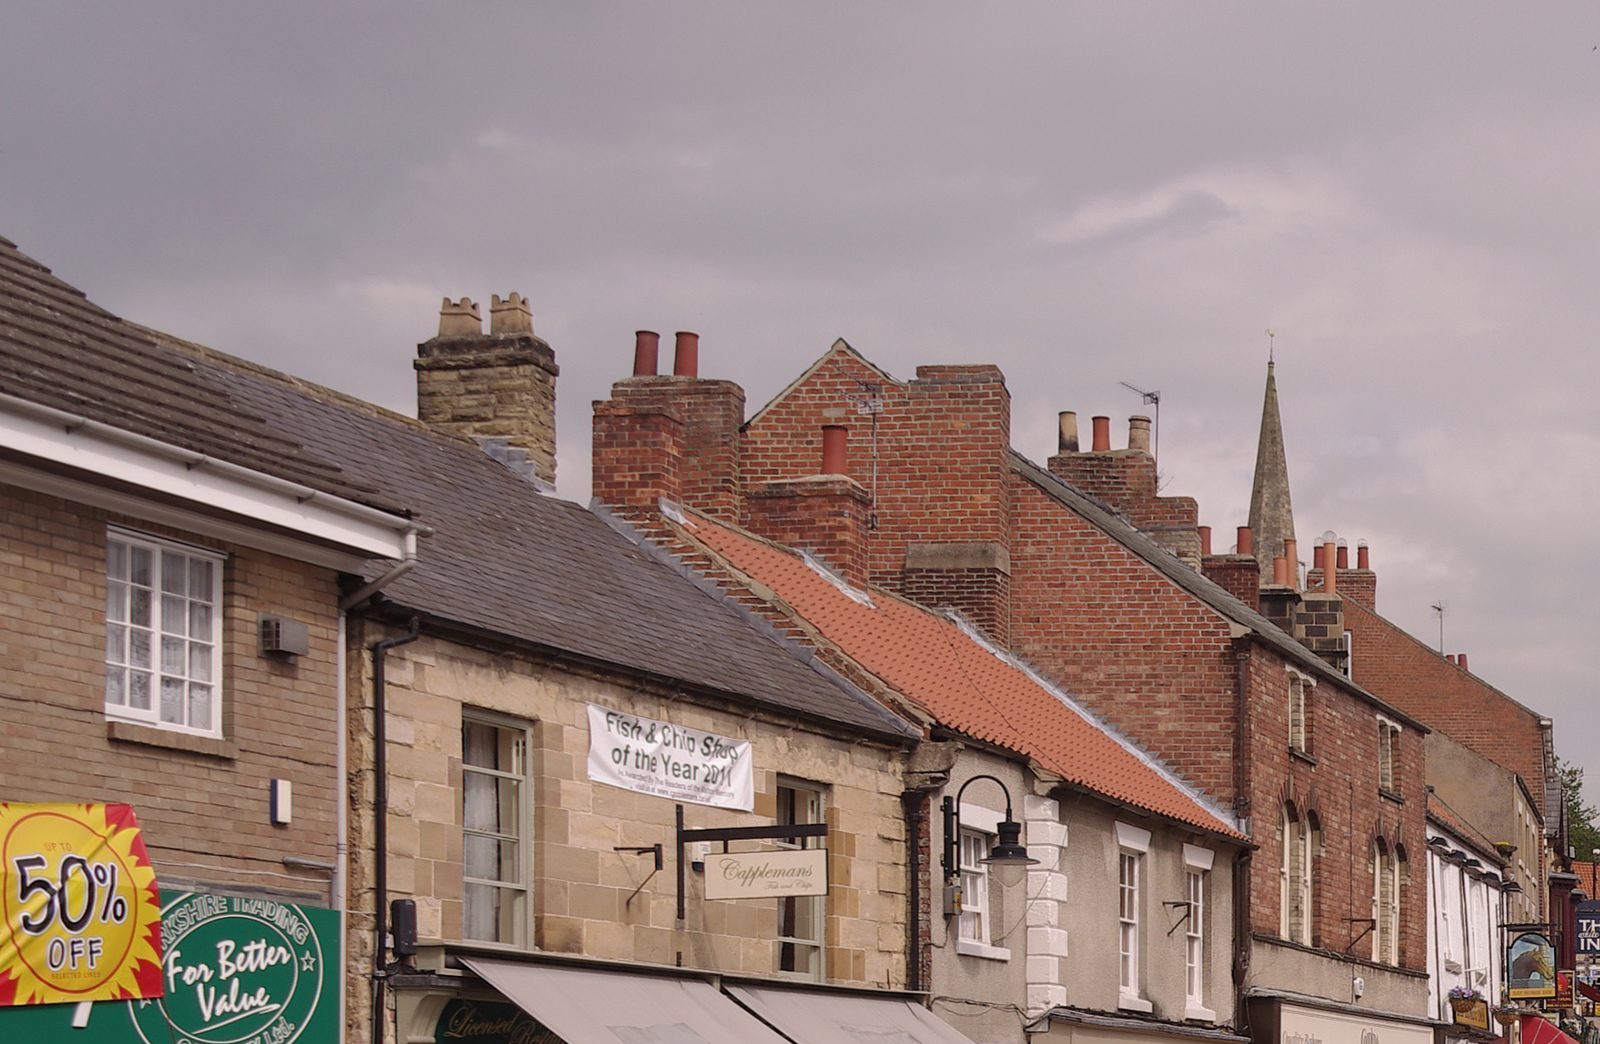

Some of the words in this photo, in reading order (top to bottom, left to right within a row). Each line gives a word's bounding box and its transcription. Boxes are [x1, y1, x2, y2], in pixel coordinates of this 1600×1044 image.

[606, 711, 642, 741] Fish
[645, 723, 658, 744] &
[661, 725, 696, 757] Chip
[701, 736, 739, 765] Shop
[612, 744, 630, 766] of
[635, 749, 658, 773] the
[661, 753, 699, 780] Year
[703, 763, 732, 787] 2011
[59, 843, 72, 851] TO
[720, 858, 813, 887] Capplemans
[13, 855, 126, 935] 50%
[49, 937, 103, 970] OFF
[167, 950, 214, 993] For
[217, 939, 291, 980] Better
[197, 978, 270, 1022] Value
